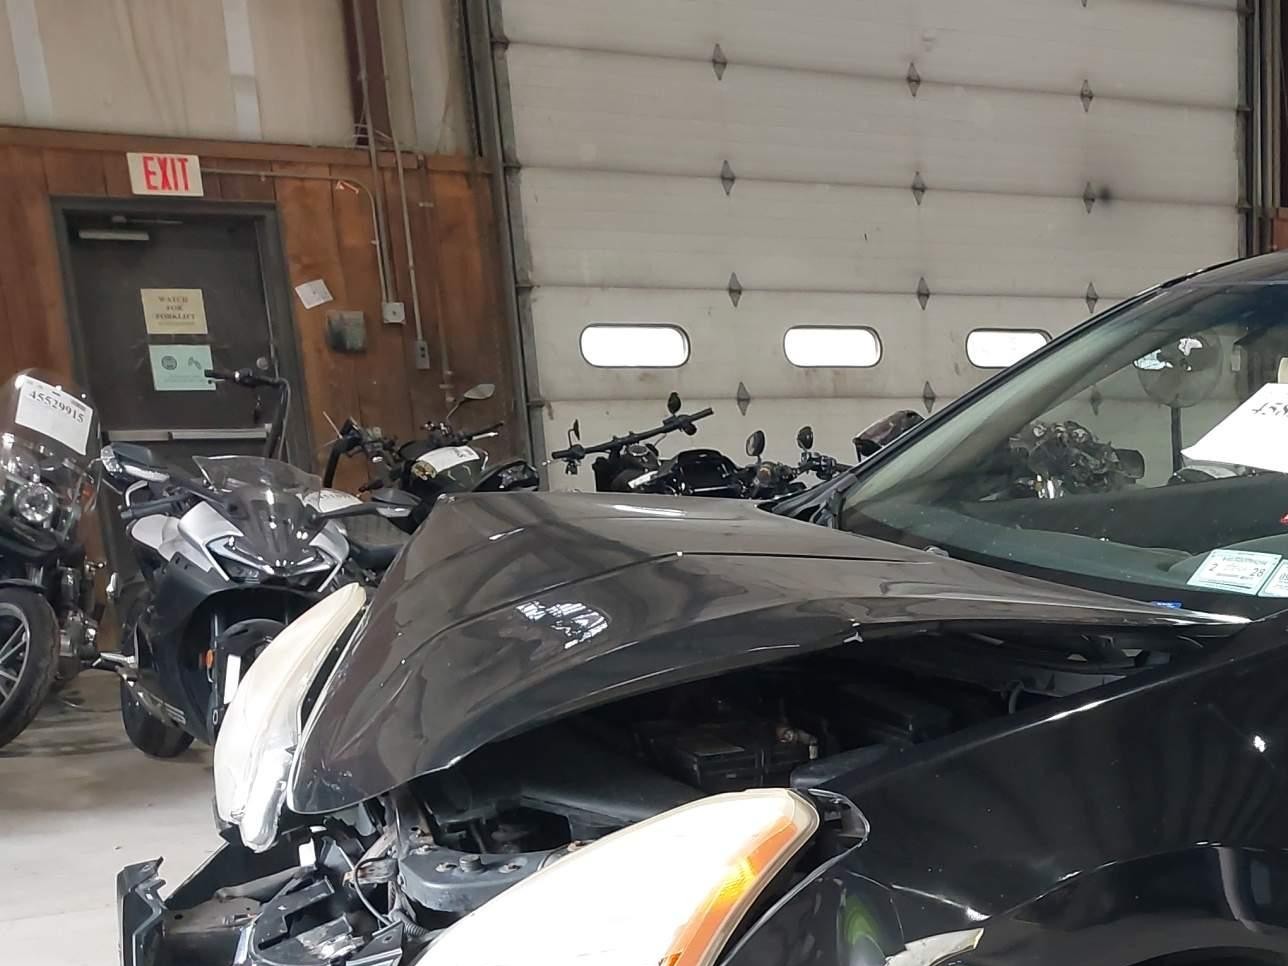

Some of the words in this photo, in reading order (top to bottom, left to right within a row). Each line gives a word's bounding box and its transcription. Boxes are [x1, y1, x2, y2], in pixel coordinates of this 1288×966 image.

[143, 156, 189, 191] EXIT
[29, 389, 85, 423] 45529915
[1250, 568, 1265, 577] 28
